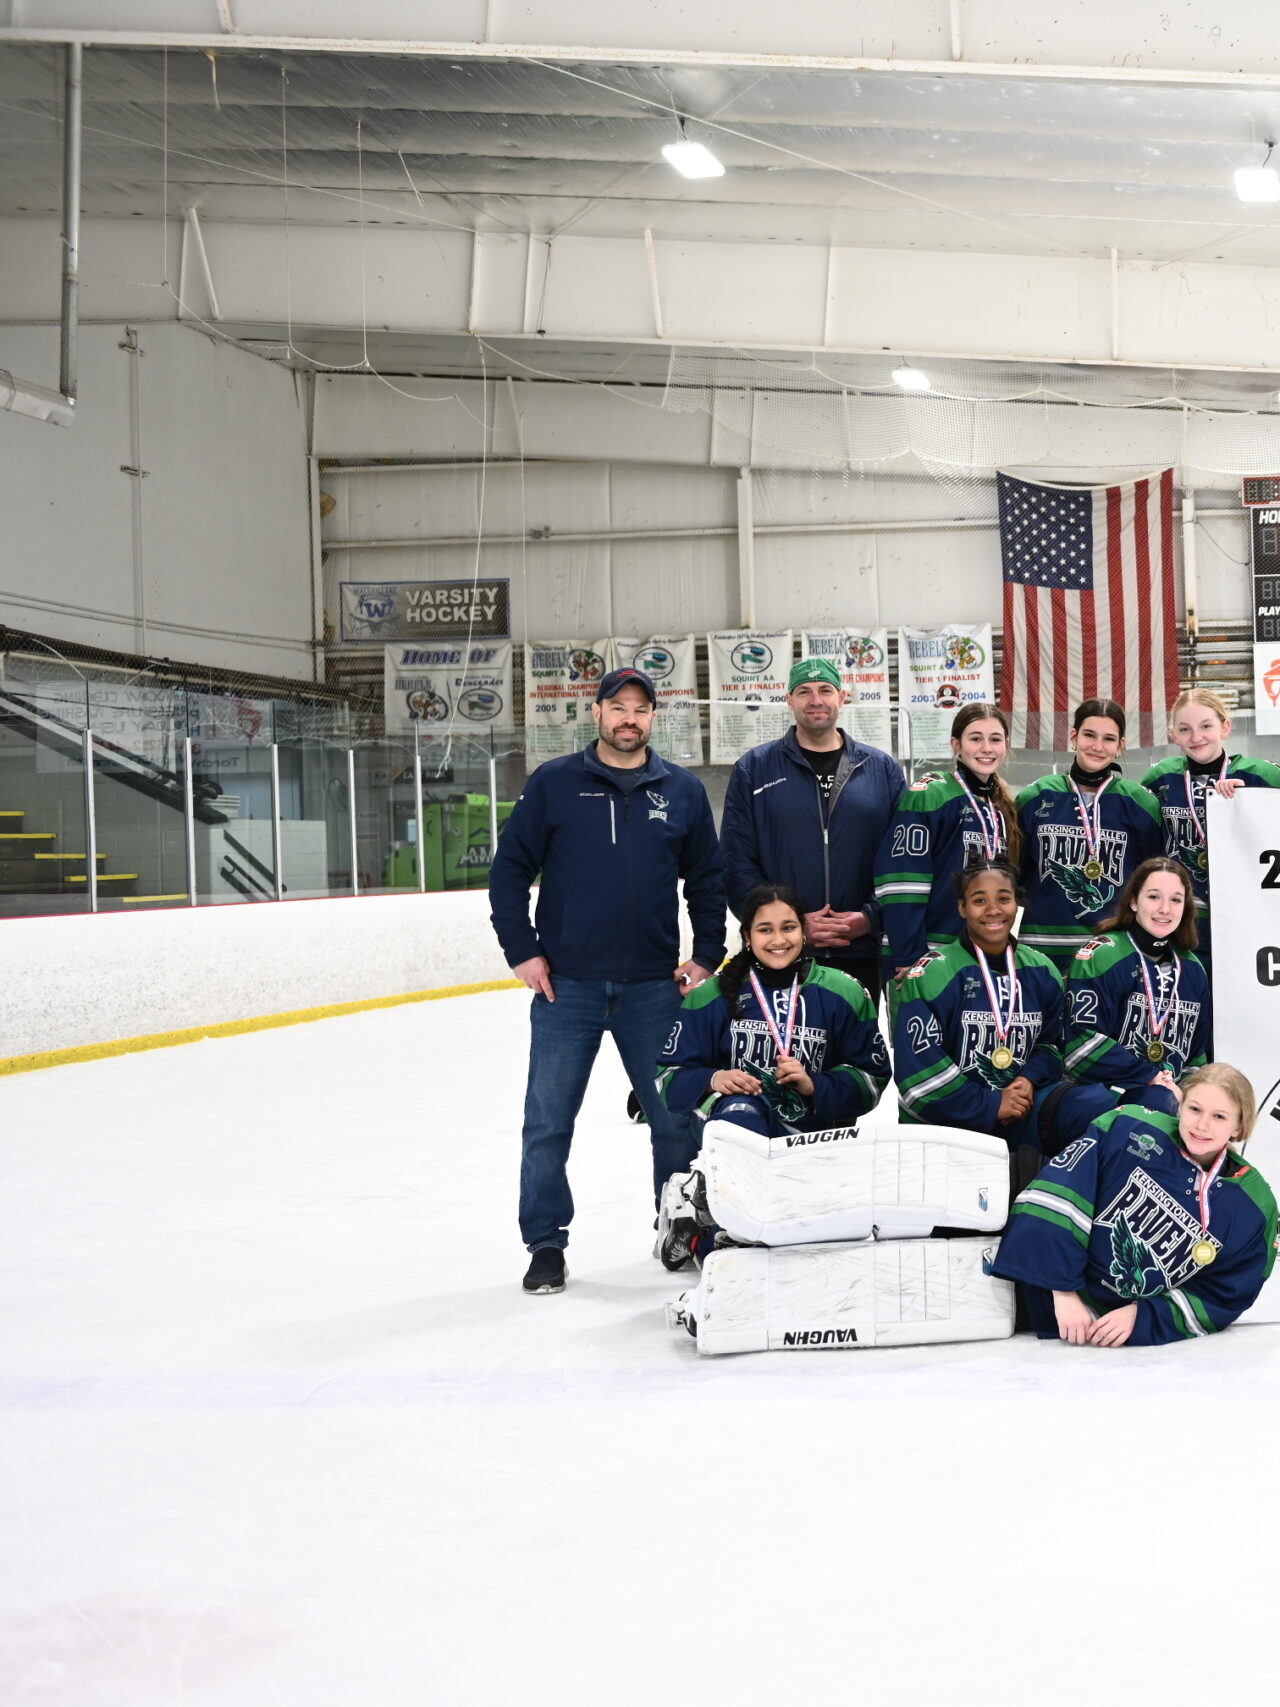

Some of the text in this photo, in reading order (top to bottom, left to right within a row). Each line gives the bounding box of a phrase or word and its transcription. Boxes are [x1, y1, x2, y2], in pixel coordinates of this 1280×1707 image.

[406, 588, 498, 605] VARSITY
[406, 606, 498, 622] HOCKEY
[808, 638, 847, 656] REBELS
[910, 640, 946, 659] REBELS
[401, 650, 461, 664] HOME
[532, 670, 558, 678] SQUIRT
[910, 664, 936, 672] SQUIRT
[764, 674, 774, 682] AA
[856, 674, 884, 684] CHAMPIONS
[915, 676, 934, 684] TIER
[530, 690, 579, 698] INTERNATIONAL
[721, 684, 738, 692] TIER
[750, 682, 786, 690] FINALIST
[860, 692, 881, 700] 2005
[912, 695, 936, 703] 2003
[962, 692, 986, 700] 2004
[536, 704, 556, 712] 2005
[892, 823, 930, 857] 20
[1038, 824, 1127, 842] KENSINGTO ALLEY
[907, 1014, 944, 1054] 24
[786, 1128, 860, 1148] VAUGHN
[1050, 1138, 1098, 1172] 31
[1132, 1167, 1189, 1225] KENSINGTON
[784, 1328, 858, 1346] VAUGHN
